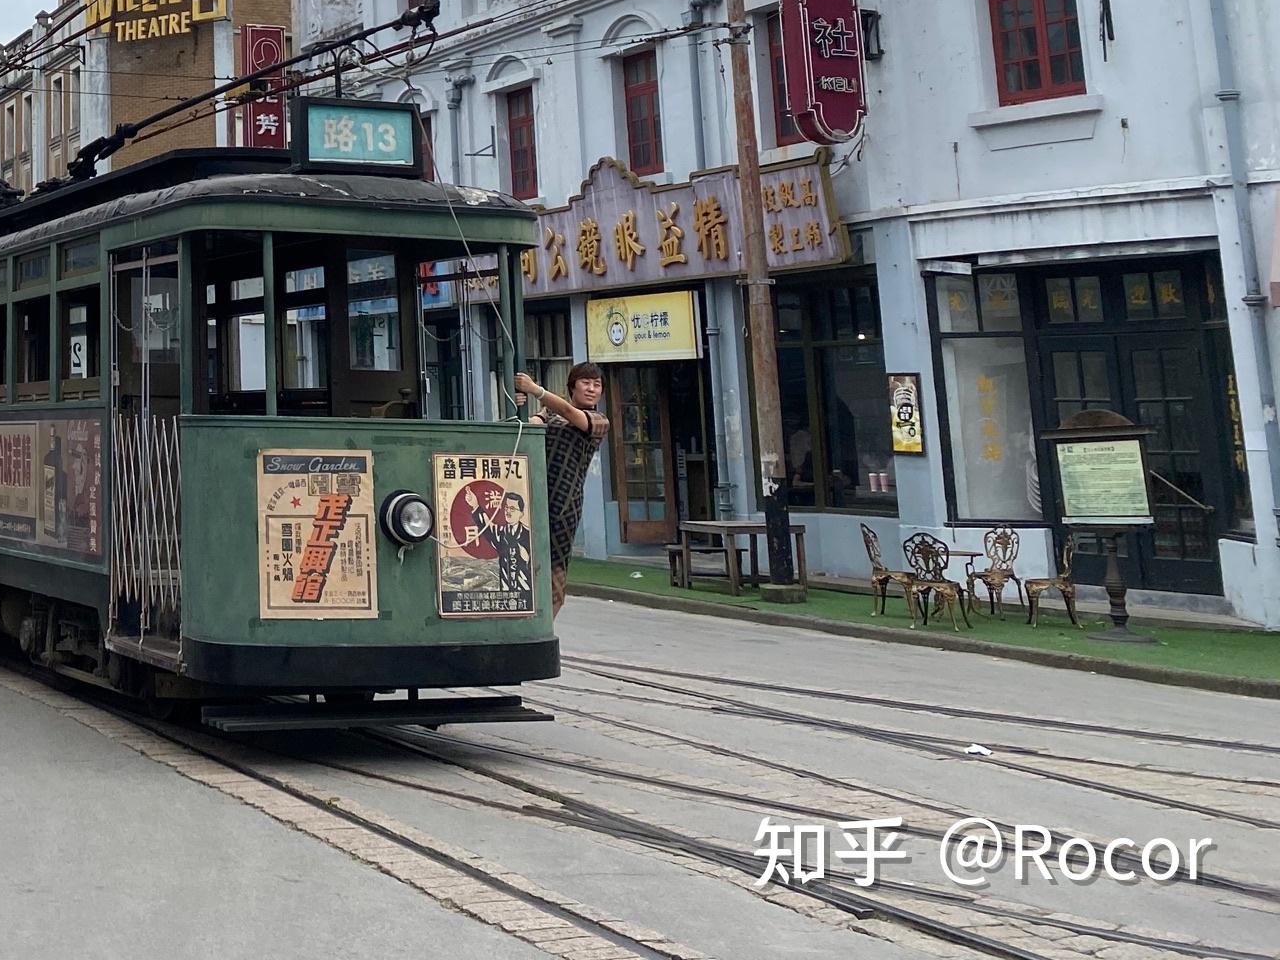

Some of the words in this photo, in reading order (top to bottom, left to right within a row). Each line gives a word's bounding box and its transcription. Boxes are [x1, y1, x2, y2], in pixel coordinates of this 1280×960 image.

[114, 11, 191, 42] THEATRE
[266, 456, 306, 472] Snow
[308, 456, 360, 472] Garden
